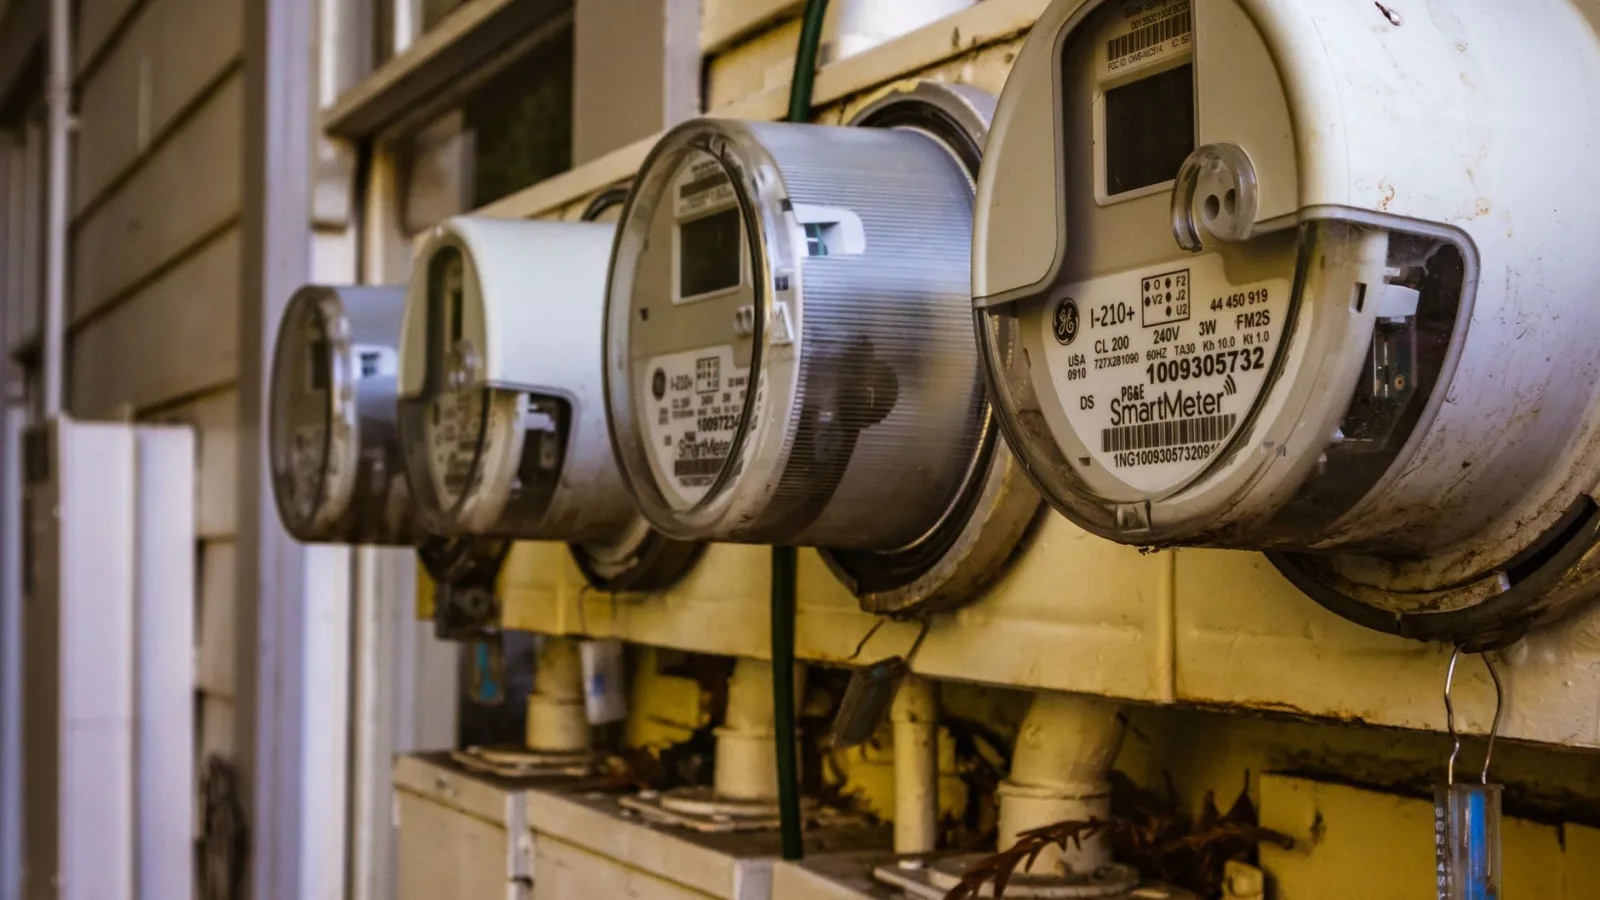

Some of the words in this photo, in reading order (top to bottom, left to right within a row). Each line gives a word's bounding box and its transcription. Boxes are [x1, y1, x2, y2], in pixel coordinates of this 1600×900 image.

[1176, 275, 1187, 288] F2
[1151, 294, 1163, 305] V2
[1176, 289, 1186, 302] J2
[1210, 297, 1223, 312] 44
[1225, 292, 1245, 309] 450
[1247, 288, 1268, 305] 919
[1090, 301, 1136, 329] I-210+
[1176, 303, 1187, 316] U2
[1094, 339, 1109, 354] CL
[1111, 335, 1129, 352] 200
[1153, 325, 1180, 345] 240V
[1198, 319, 1217, 337] 3W
[1236, 309, 1271, 330] FM2S
[1146, 347, 1168, 361] 60HZ
[1174, 342, 1196, 356] TA30
[1203, 340, 1215, 352] Kh
[1217, 335, 1236, 349] 10.0
[1243, 333, 1254, 345] Kt
[1256, 330, 1270, 343] 1.0
[1068, 353, 1086, 368] USA
[1146, 346, 1265, 385] 1009305732
[1067, 367, 1087, 381] 0910
[1080, 394, 1095, 410] DS
[1121, 383, 1145, 402] PG&E
[1110, 389, 1225, 426] SmartMeter
